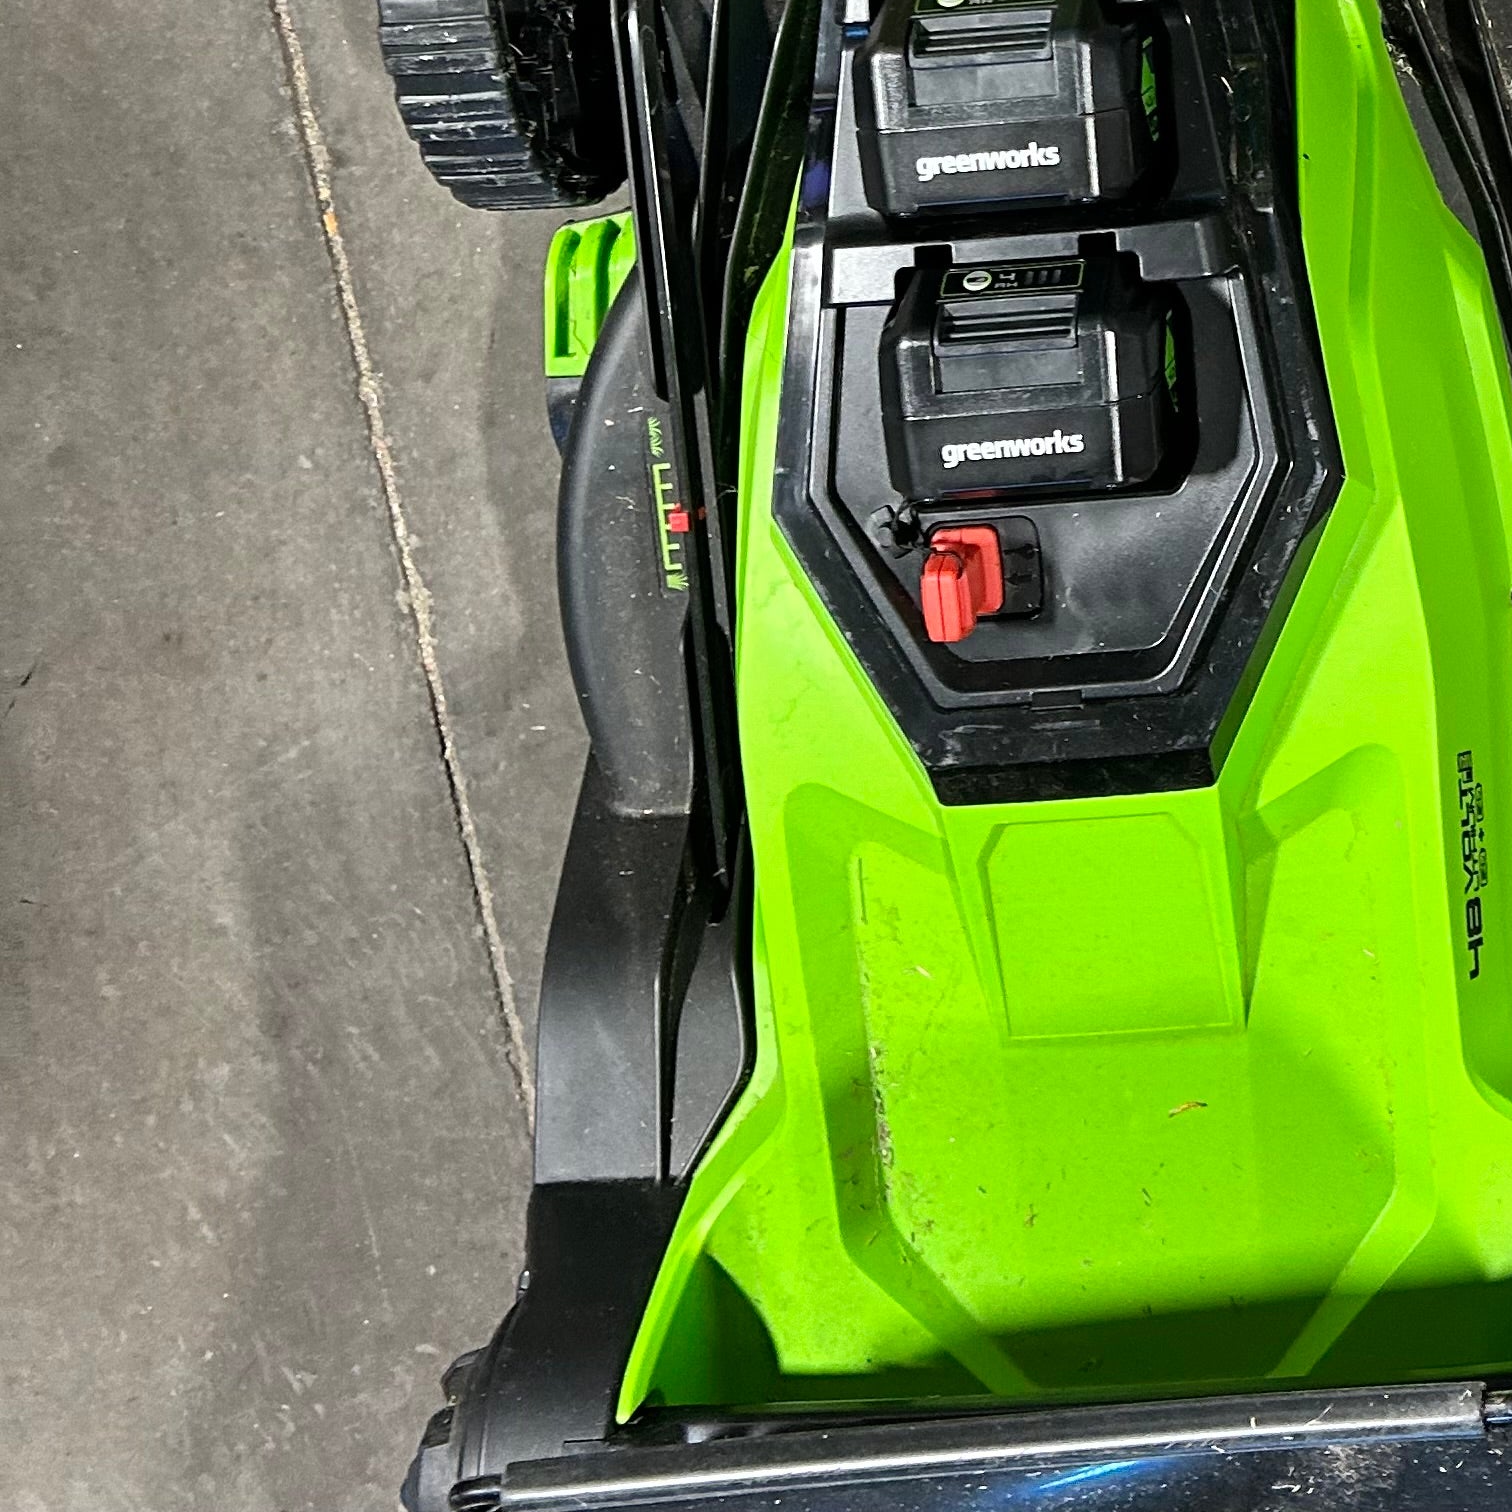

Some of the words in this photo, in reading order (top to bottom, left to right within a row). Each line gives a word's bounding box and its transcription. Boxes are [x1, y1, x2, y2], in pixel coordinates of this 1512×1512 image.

[916, 142, 1060, 182] greenworks
[941, 429, 1085, 468] greenworks
[1465, 896, 1483, 980] 48
